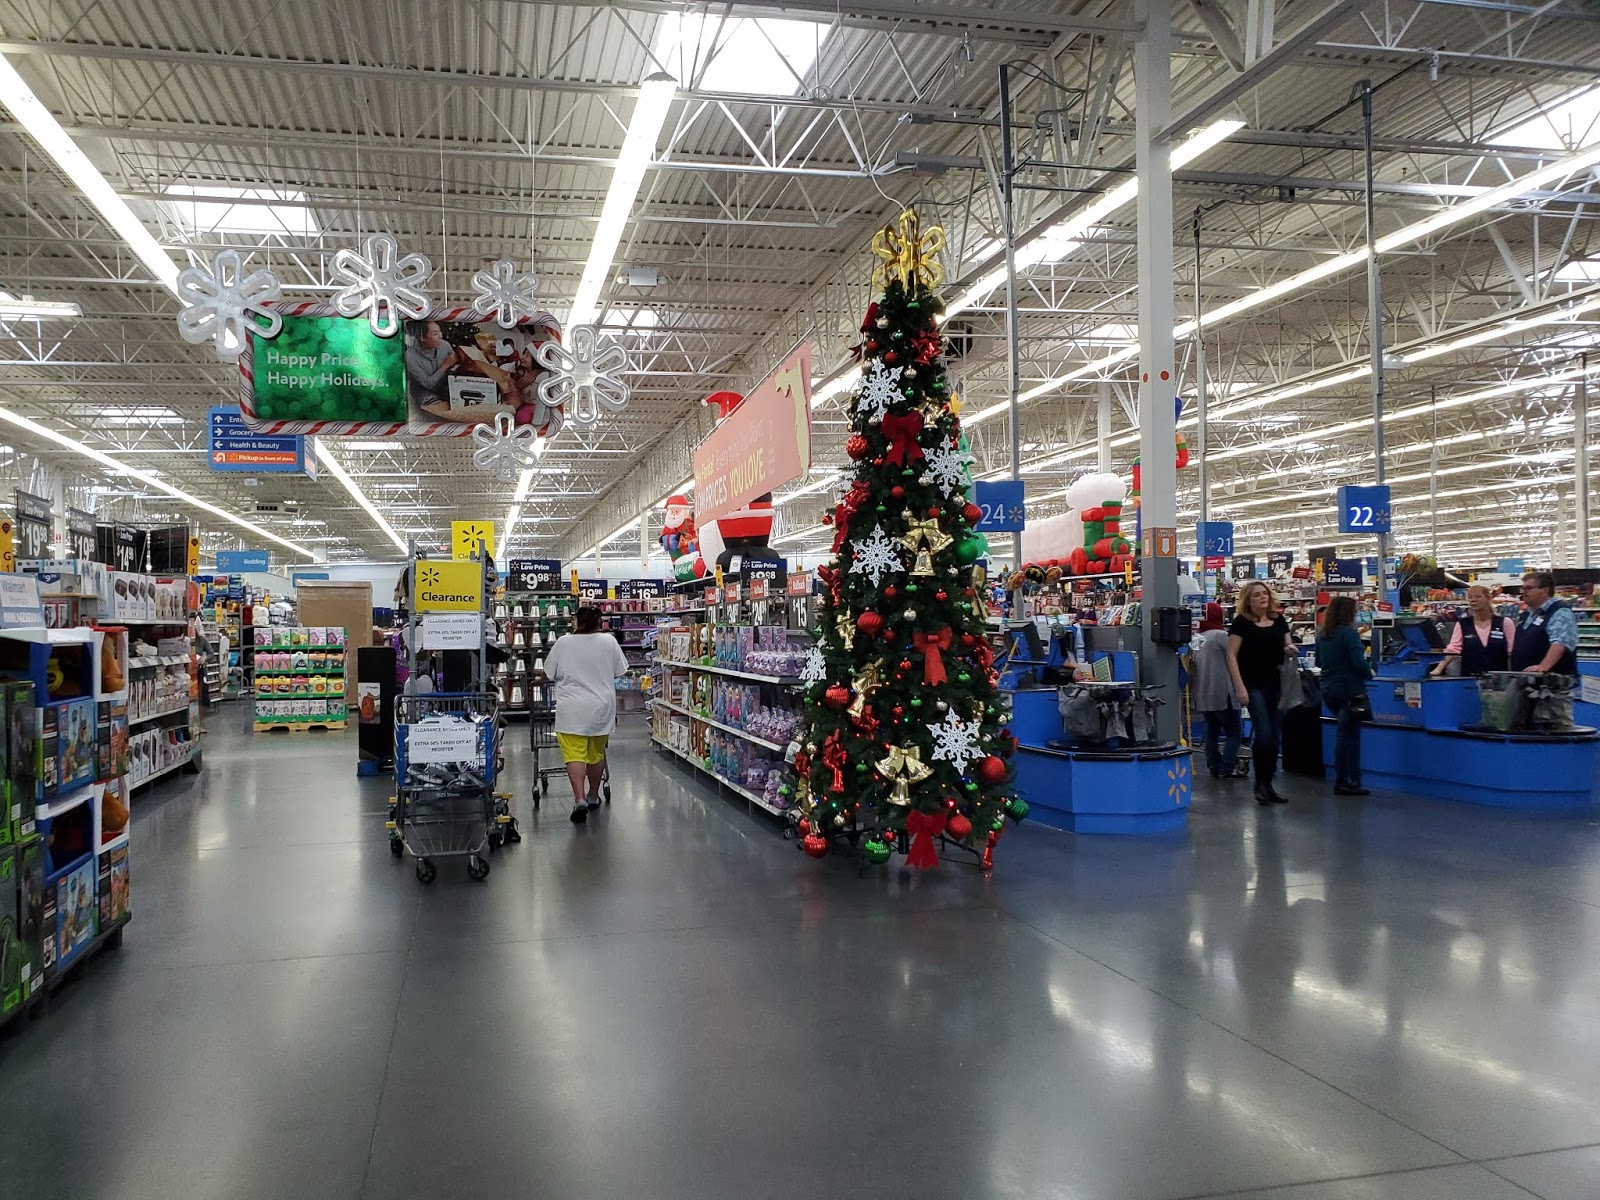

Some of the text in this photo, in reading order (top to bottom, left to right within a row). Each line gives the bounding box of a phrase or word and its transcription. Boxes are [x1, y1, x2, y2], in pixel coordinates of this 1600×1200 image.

[267, 351, 317, 369] Happy
[267, 371, 389, 390] Happy Holidays.
[229, 429, 254, 437] Grocery
[258, 442, 280, 450] Beauty
[705, 474, 728, 512] PRICES
[730, 463, 744, 499] YOU
[980, 503, 1006, 525] 24
[1350, 506, 1374, 527] 22
[1217, 537, 1231, 553] 21
[3, 551, 11, 561] G
[190, 558, 197, 566] G
[421, 592, 475, 603] Clearance
